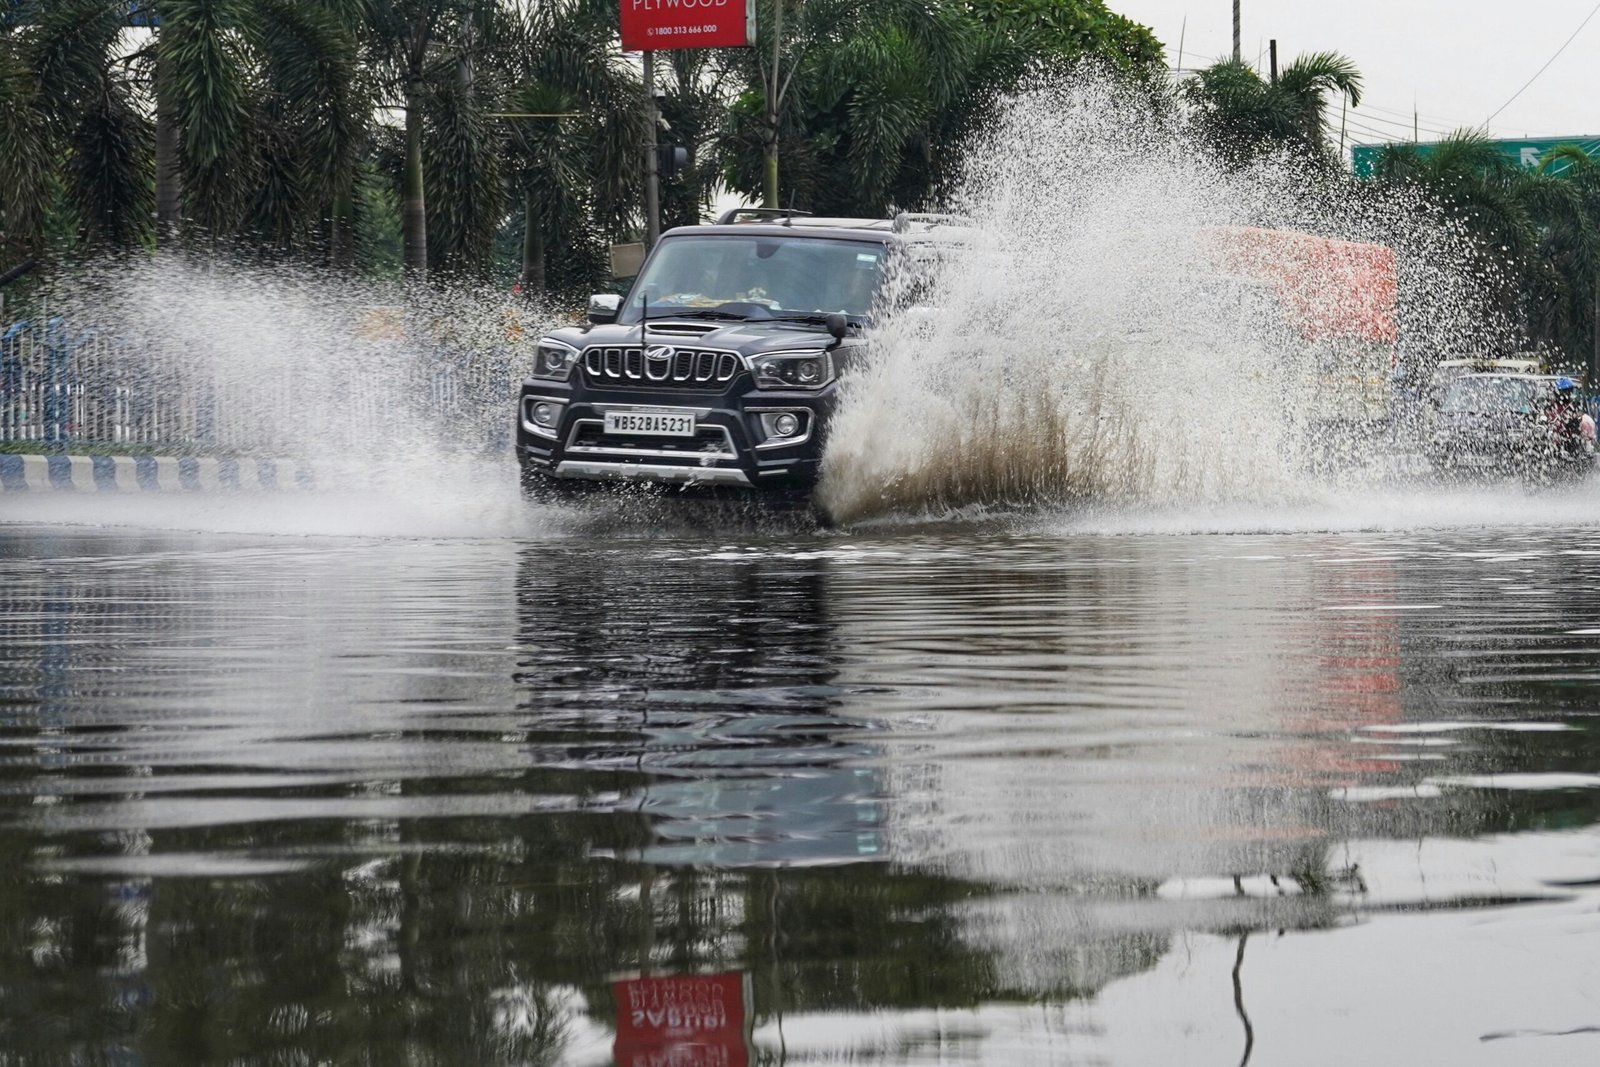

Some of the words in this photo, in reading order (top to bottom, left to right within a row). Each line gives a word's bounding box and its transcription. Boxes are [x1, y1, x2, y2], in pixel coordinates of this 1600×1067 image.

[655, 27, 673, 35] 1800
[673, 26, 687, 35] 313
[688, 25, 702, 34] 666
[703, 24, 717, 33] 000
[613, 415, 692, 432] WB52BA5231
